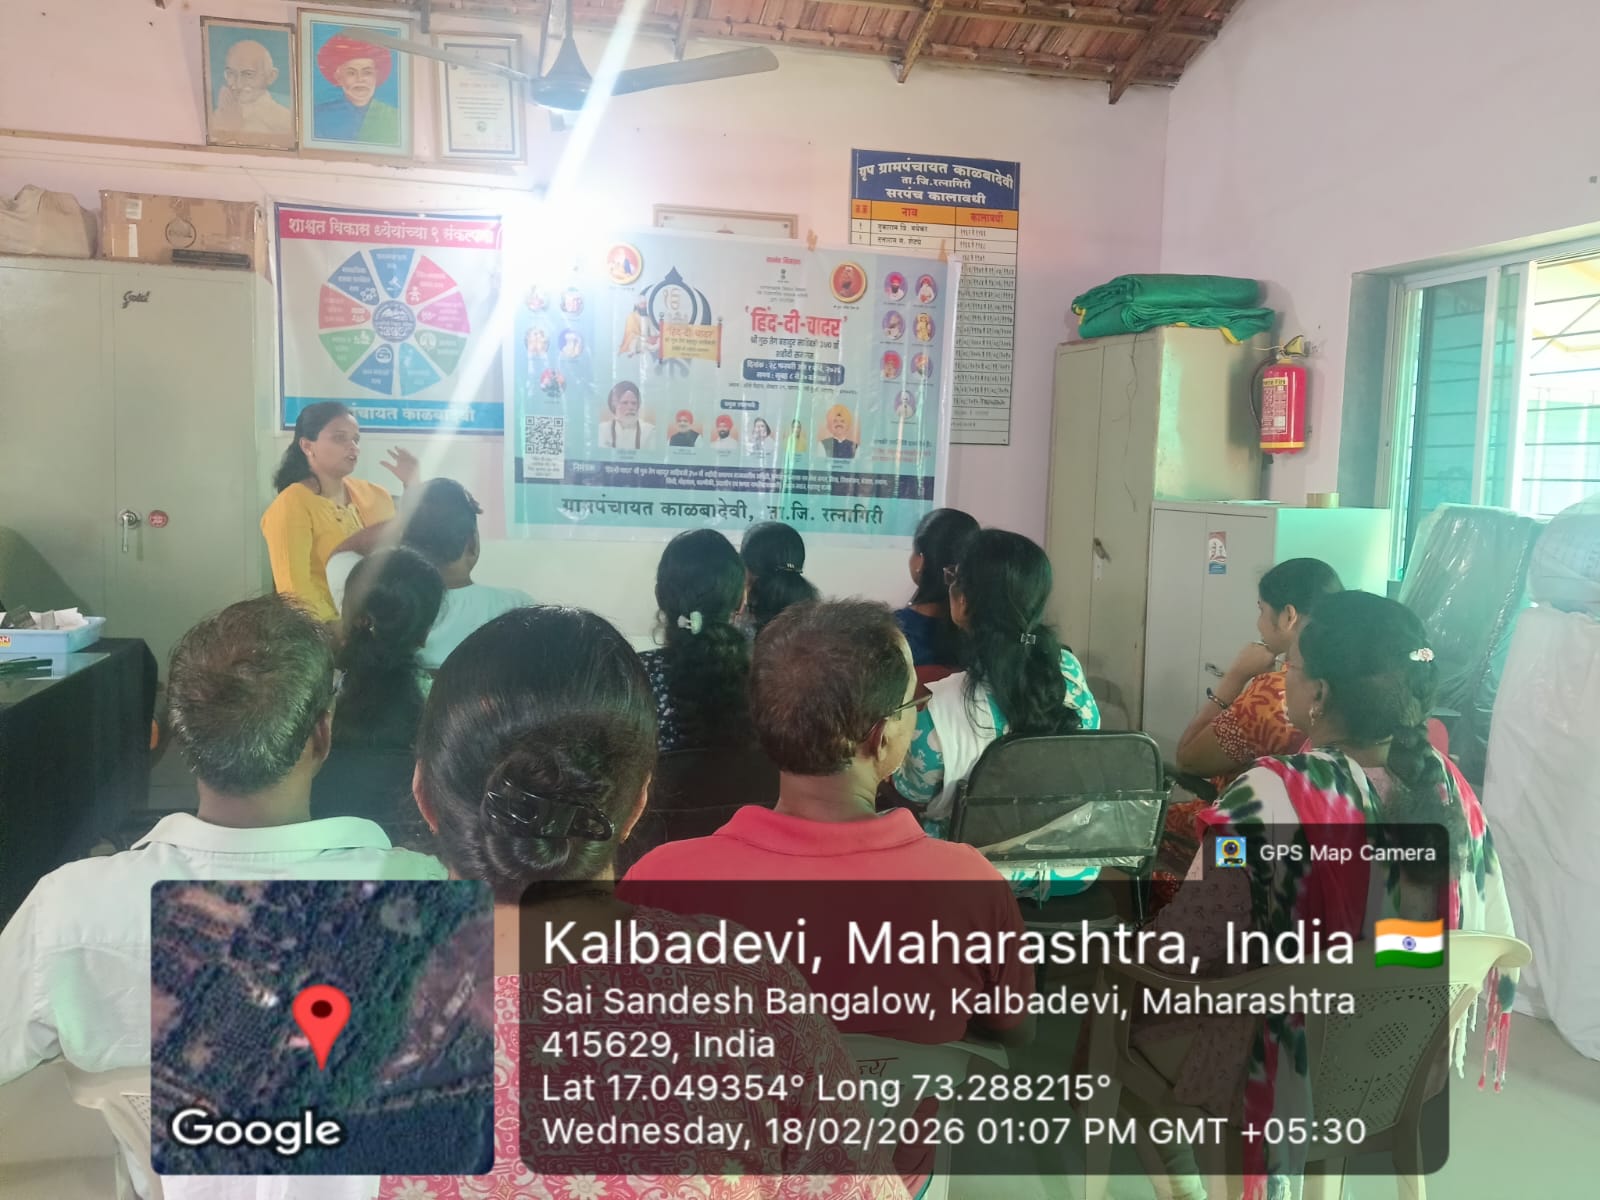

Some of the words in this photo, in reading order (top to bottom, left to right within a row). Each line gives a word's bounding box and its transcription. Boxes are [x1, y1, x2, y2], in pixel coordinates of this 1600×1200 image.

[878, 157, 949, 175] ग्रामपंचायत
[952, 164, 1014, 190] काळबादेवी
[884, 186, 924, 200] सरपंच
[927, 191, 986, 205] कालावधी
[288, 218, 326, 235] शाश्वत
[329, 217, 371, 237] विकास
[659, 498, 754, 522] काळबादेवी,
[821, 503, 884, 525] रत्नागिरी
